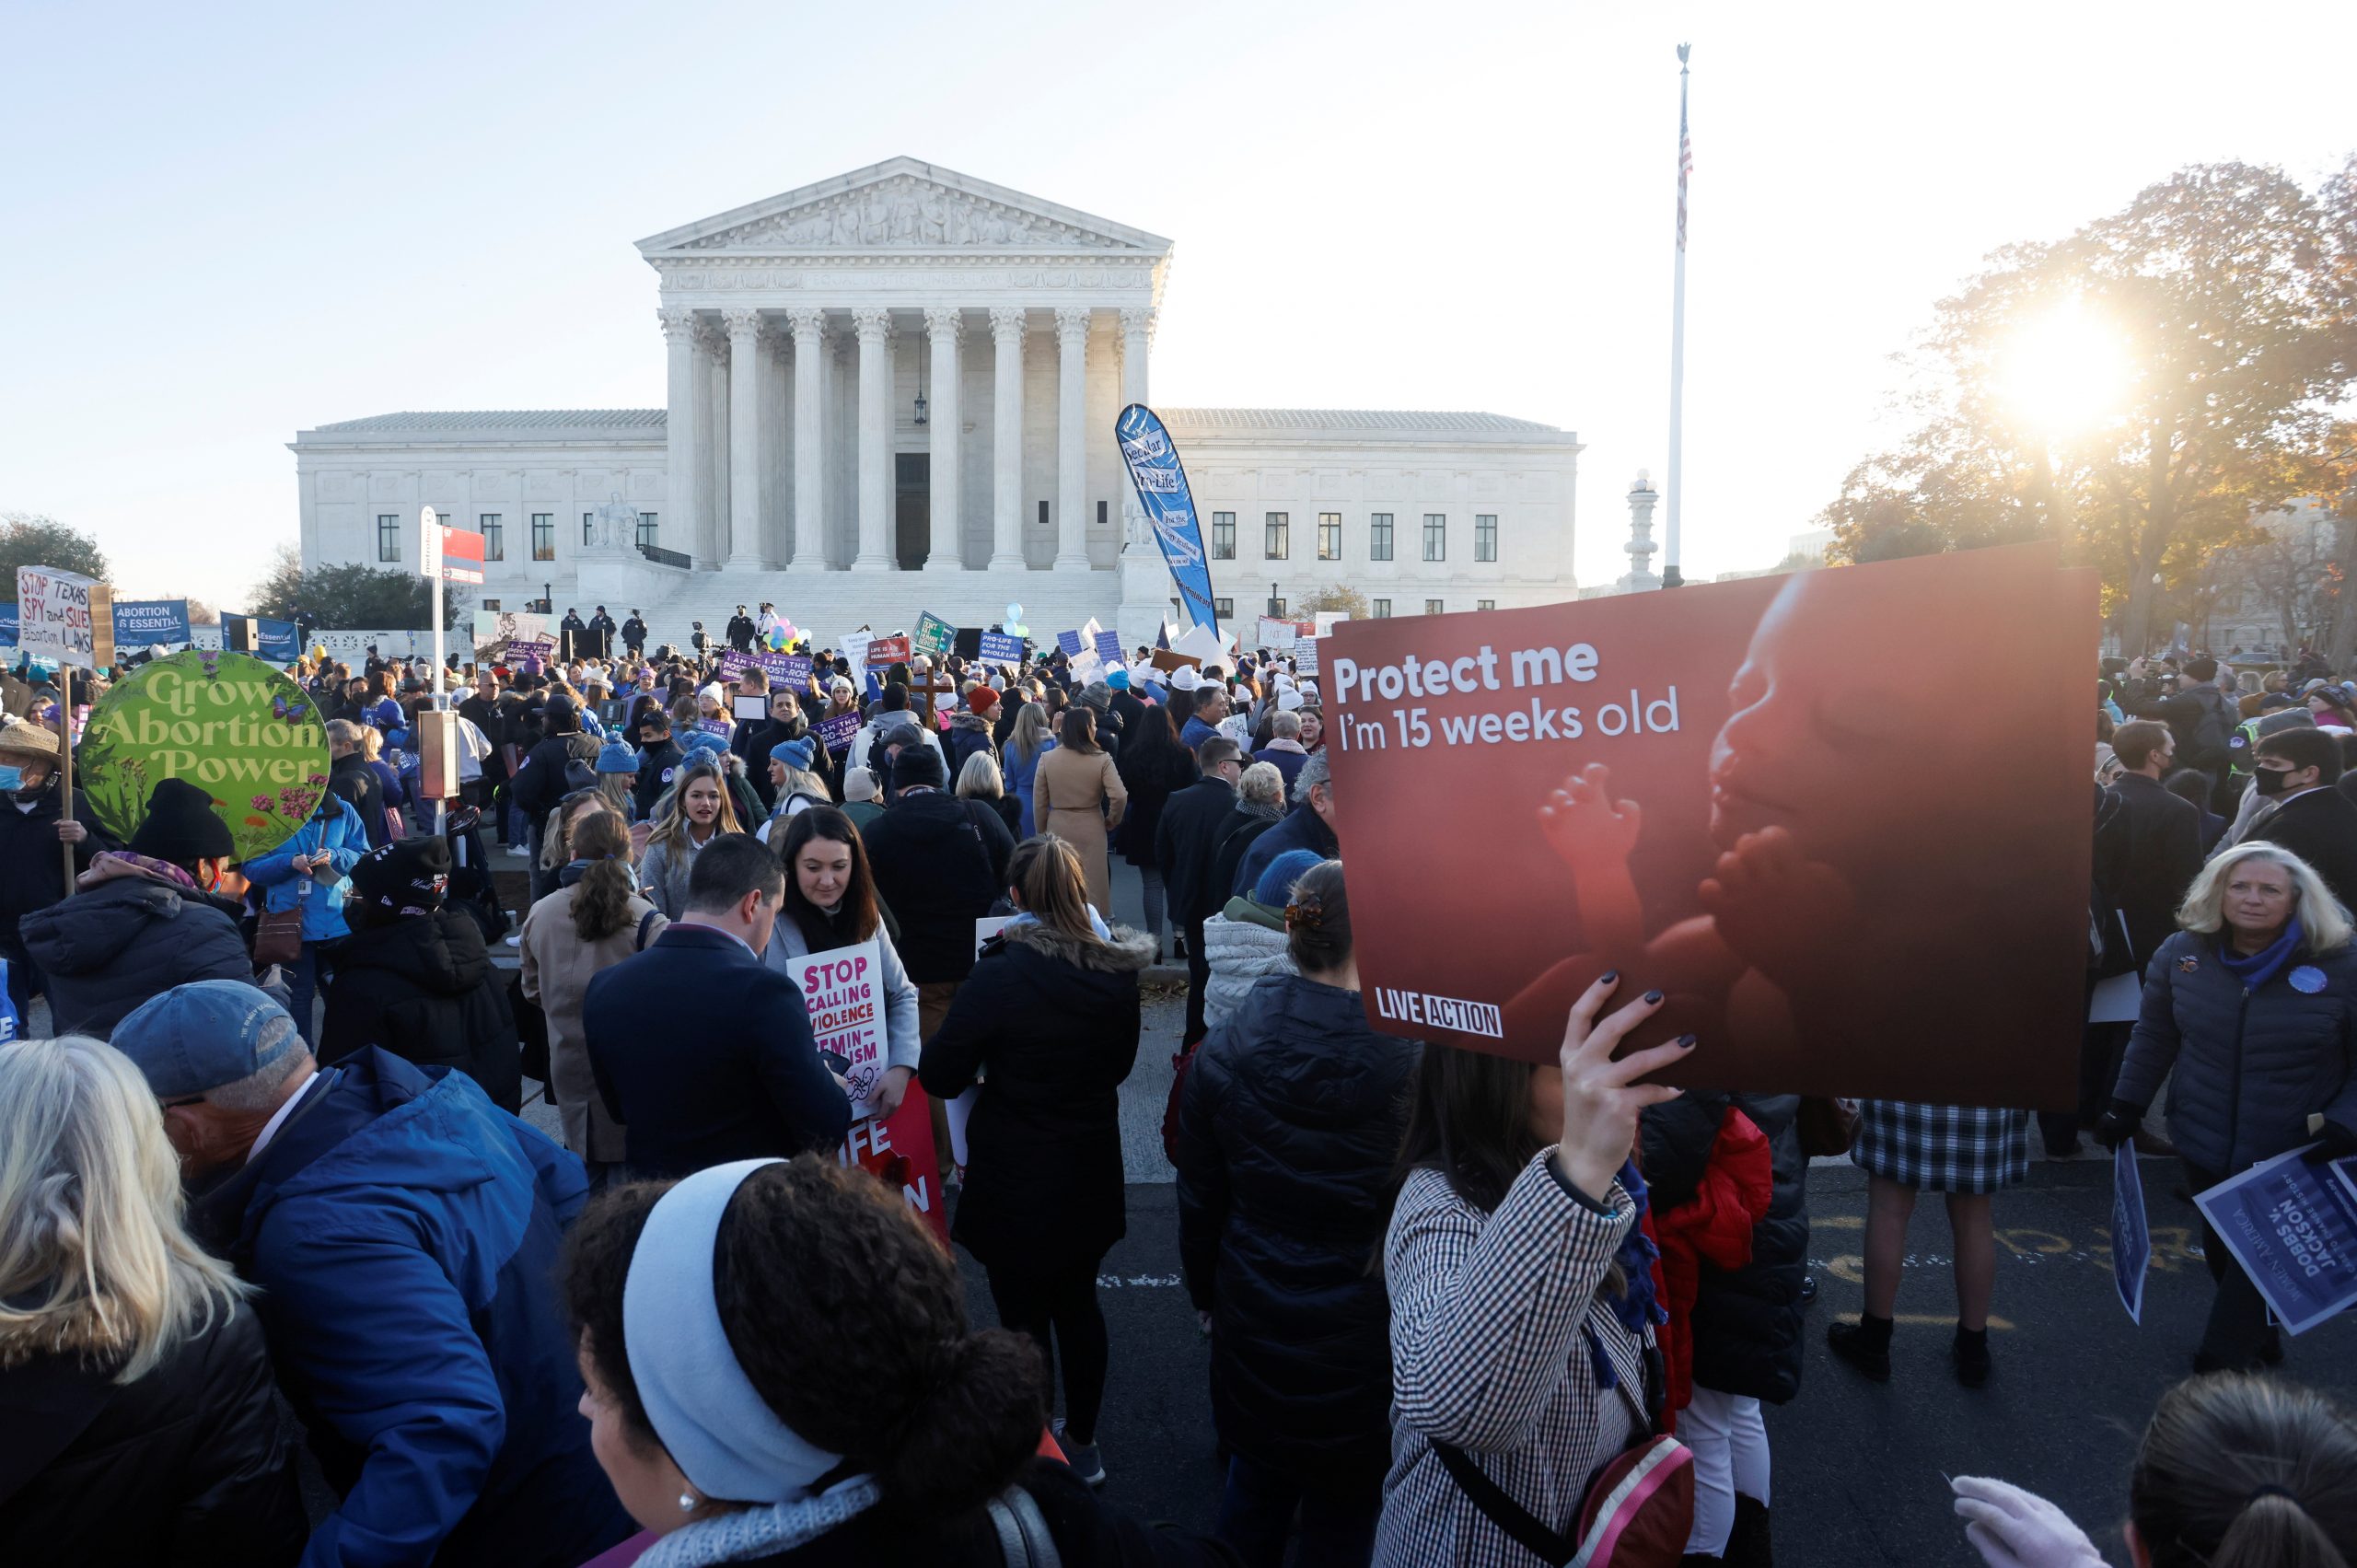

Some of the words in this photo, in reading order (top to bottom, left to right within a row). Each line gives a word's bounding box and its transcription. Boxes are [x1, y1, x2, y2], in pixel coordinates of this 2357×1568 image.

[21, 571, 48, 597] STOP
[55, 581, 87, 605] TEXAS
[24, 598, 45, 622] SPY
[46, 608, 64, 622] and
[66, 607, 89, 629] SUE
[117, 607, 170, 617] ABORTION
[24, 629, 58, 645] abortion
[982, 635, 1012, 644] PRO-LIFE
[767, 674, 807, 686] ENERATION
[1333, 645, 1501, 704] Protect
[1511, 643, 1599, 688] me
[146, 671, 282, 716] Grow
[92, 708, 319, 748] Abortion
[708, 725, 726, 733] THE
[821, 724, 836, 734] AM
[839, 717, 857, 727] THE
[1340, 714, 1386, 751] I'm
[1394, 707, 1432, 748] 15
[1440, 697, 1584, 746] weeks
[1597, 685, 1679, 736] old
[150, 749, 320, 784] Power
[805, 957, 868, 994] STOP
[807, 982, 871, 1014] CALLING
[1376, 987, 1423, 1024] LIVE
[1429, 997, 1499, 1036] ACTION
[810, 1003, 874, 1032] VIOLENCE
[816, 1030, 874, 1056] EMIN-
[850, 1042, 877, 1065] ISM
[839, 1119, 891, 1169] IFE
[2282, 1172, 2310, 1207] HISTORY
[2266, 1207, 2283, 1224] v.
[2306, 1206, 2333, 1240] CHANGE
[2231, 1208, 2274, 1260] AMERICA
[2275, 1223, 2321, 1278] DOBBS
[2278, 1198, 2337, 1272] JACKSON
